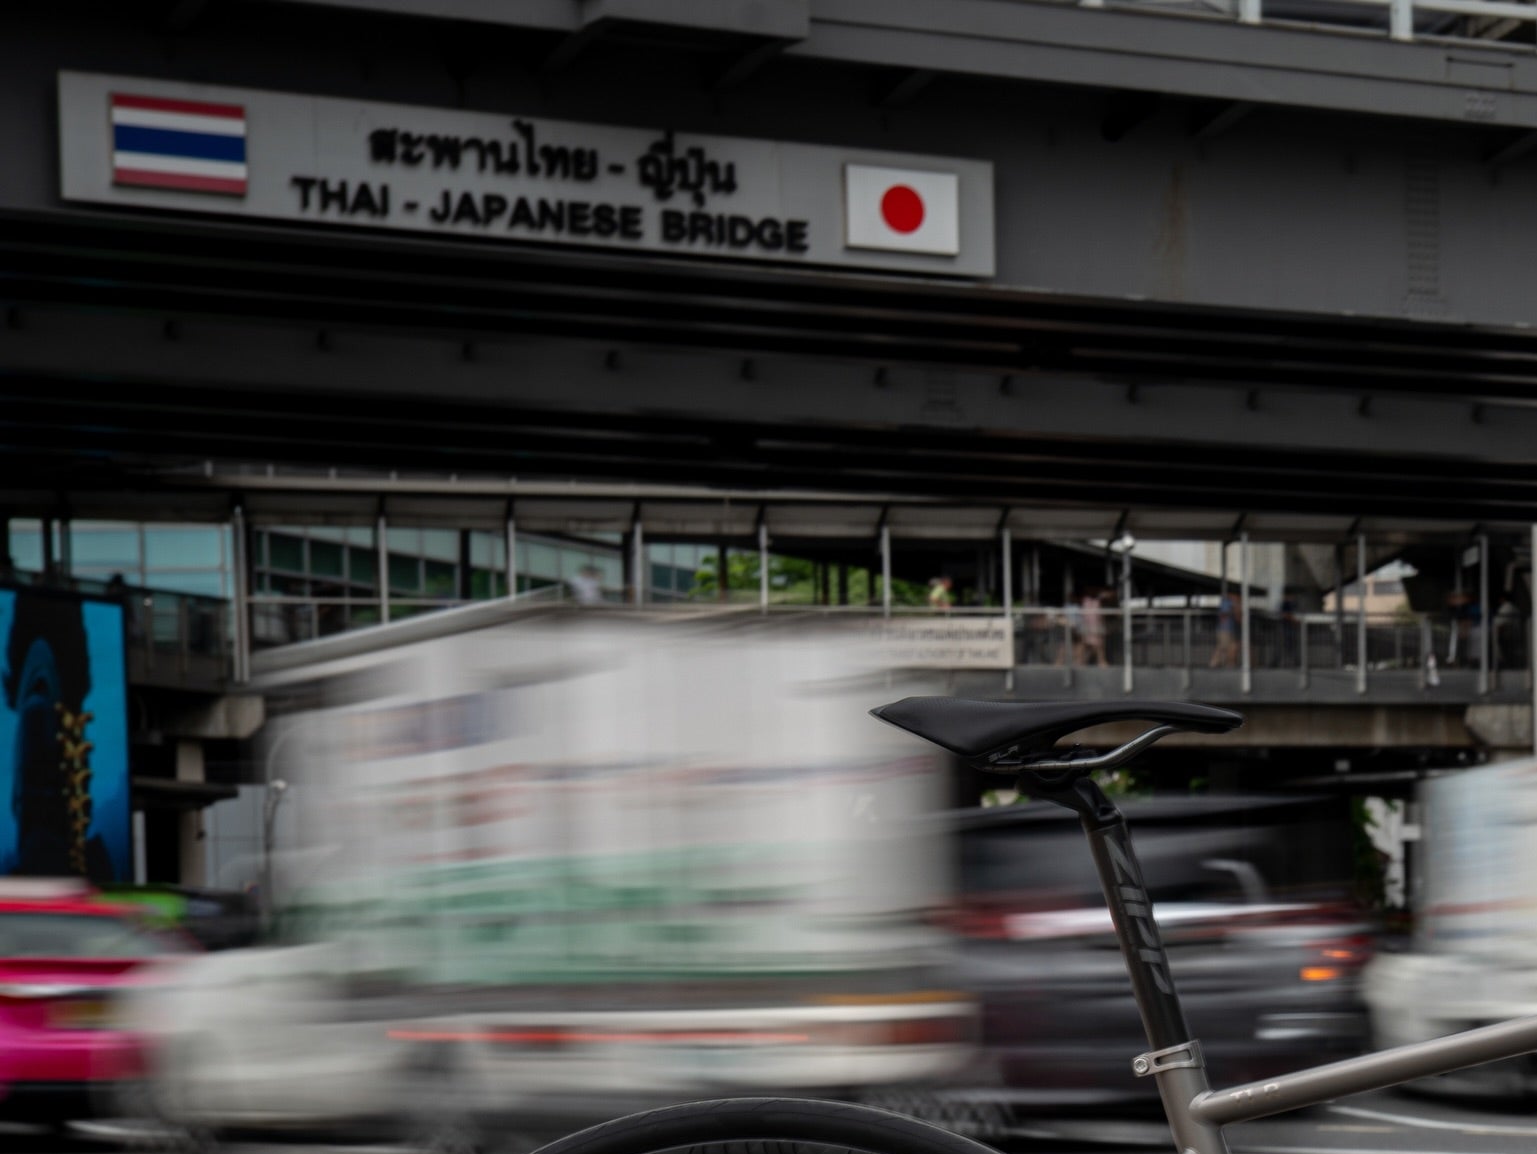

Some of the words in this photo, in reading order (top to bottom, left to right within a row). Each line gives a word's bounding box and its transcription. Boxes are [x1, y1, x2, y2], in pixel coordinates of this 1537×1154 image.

[368, 119, 597, 182] สะพานไทย
[637, 128, 738, 210] ญี่ปุ่น
[291, 176, 389, 216] THAI
[430, 189, 644, 240] JAPANESE
[660, 210, 810, 254] BRIDGE
